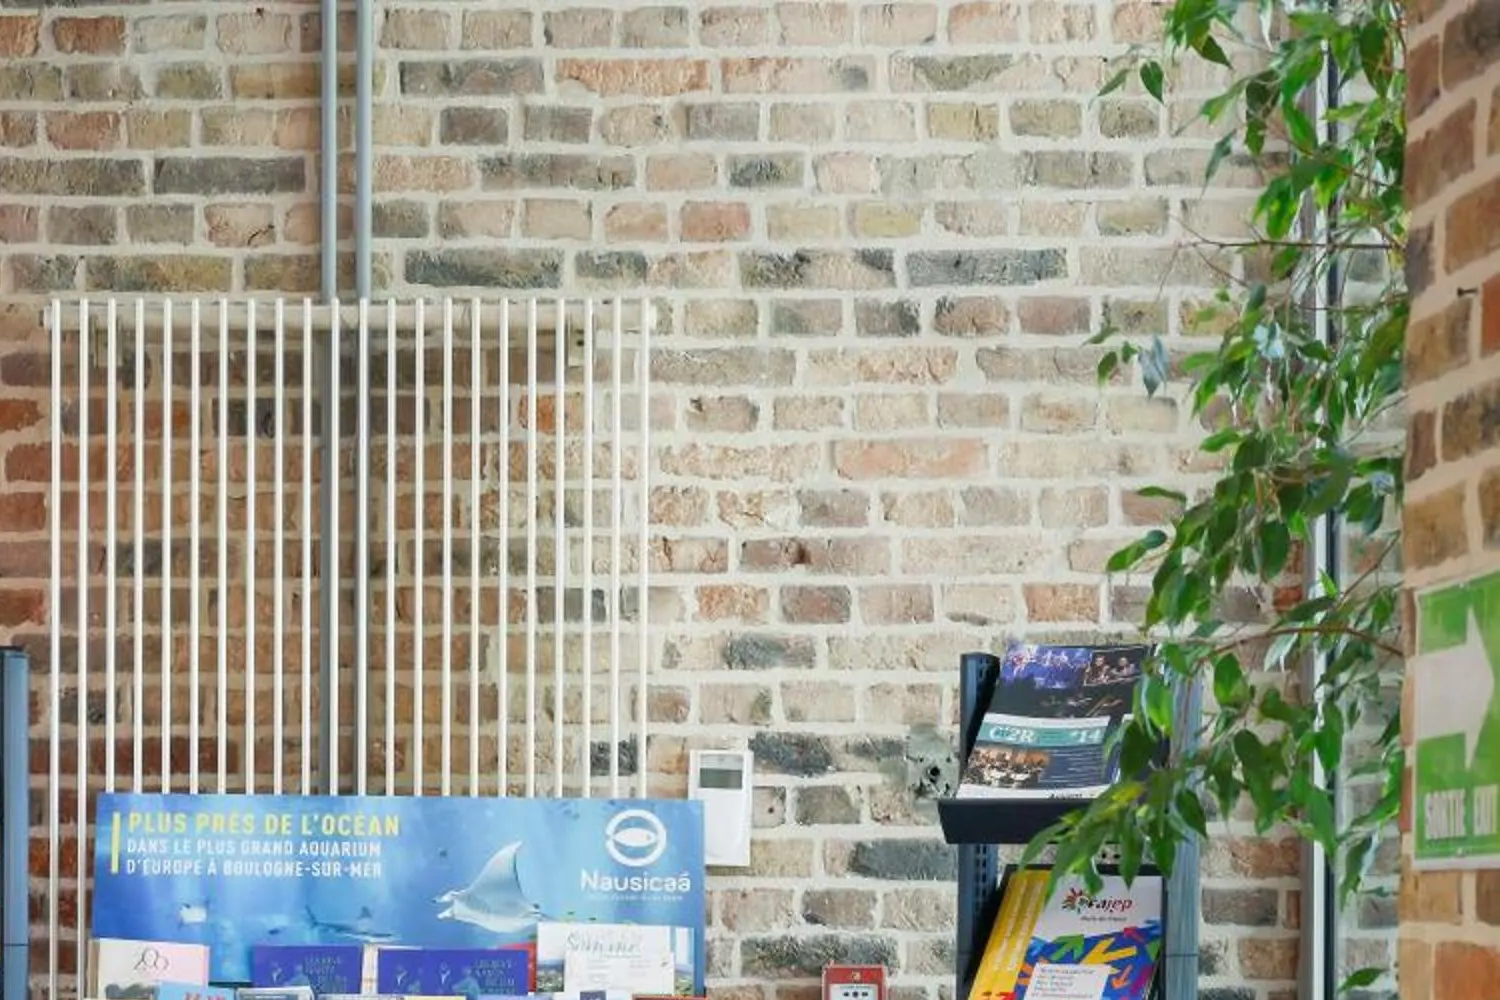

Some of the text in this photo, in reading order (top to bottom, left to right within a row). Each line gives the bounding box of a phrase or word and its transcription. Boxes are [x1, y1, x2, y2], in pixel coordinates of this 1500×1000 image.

[128, 812, 188, 834] PLUS
[264, 813, 293, 835] DE
[127, 838, 382, 857] DANS LE PLUS GRAND AQUARIUM
[223, 859, 382, 878] BOULOGNE-SUR-MER
[581, 868, 692, 892] Nausicaá
